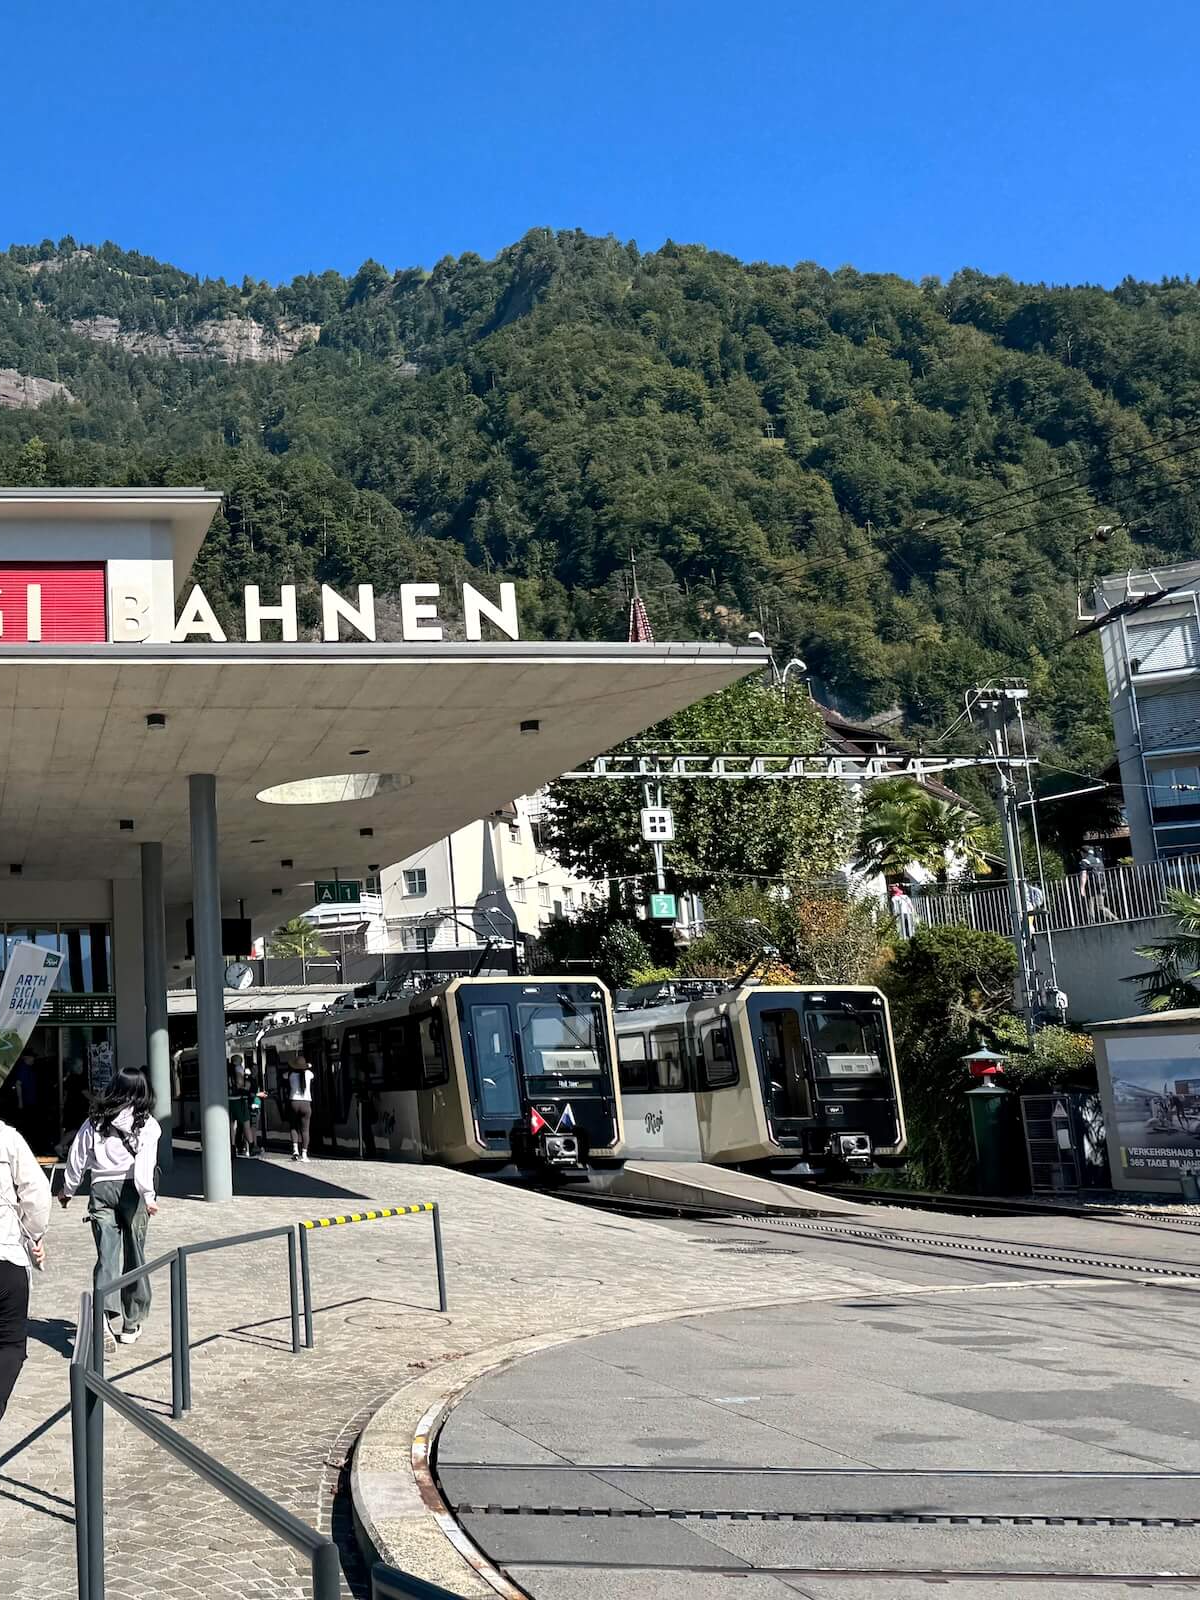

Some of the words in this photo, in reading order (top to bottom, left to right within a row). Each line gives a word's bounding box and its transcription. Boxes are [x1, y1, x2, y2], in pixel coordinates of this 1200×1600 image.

[111, 582, 520, 642] BAHNEN
[322, 888, 333, 900] A
[345, 888, 351, 900] 1
[659, 901, 669, 914] 2
[15, 974, 48, 986] ARTH
[12, 986, 36, 998] RIGI
[590, 990, 601, 999] 44
[9, 998, 43, 1010] BAHN
[644, 1109, 664, 1135] Rigi
[1128, 1147, 1194, 1157] VERKEHRSHAUS
[1129, 1159, 1145, 1167] 365
[1146, 1159, 1169, 1168] TAGE
[1169, 1160, 1180, 1168] IM
